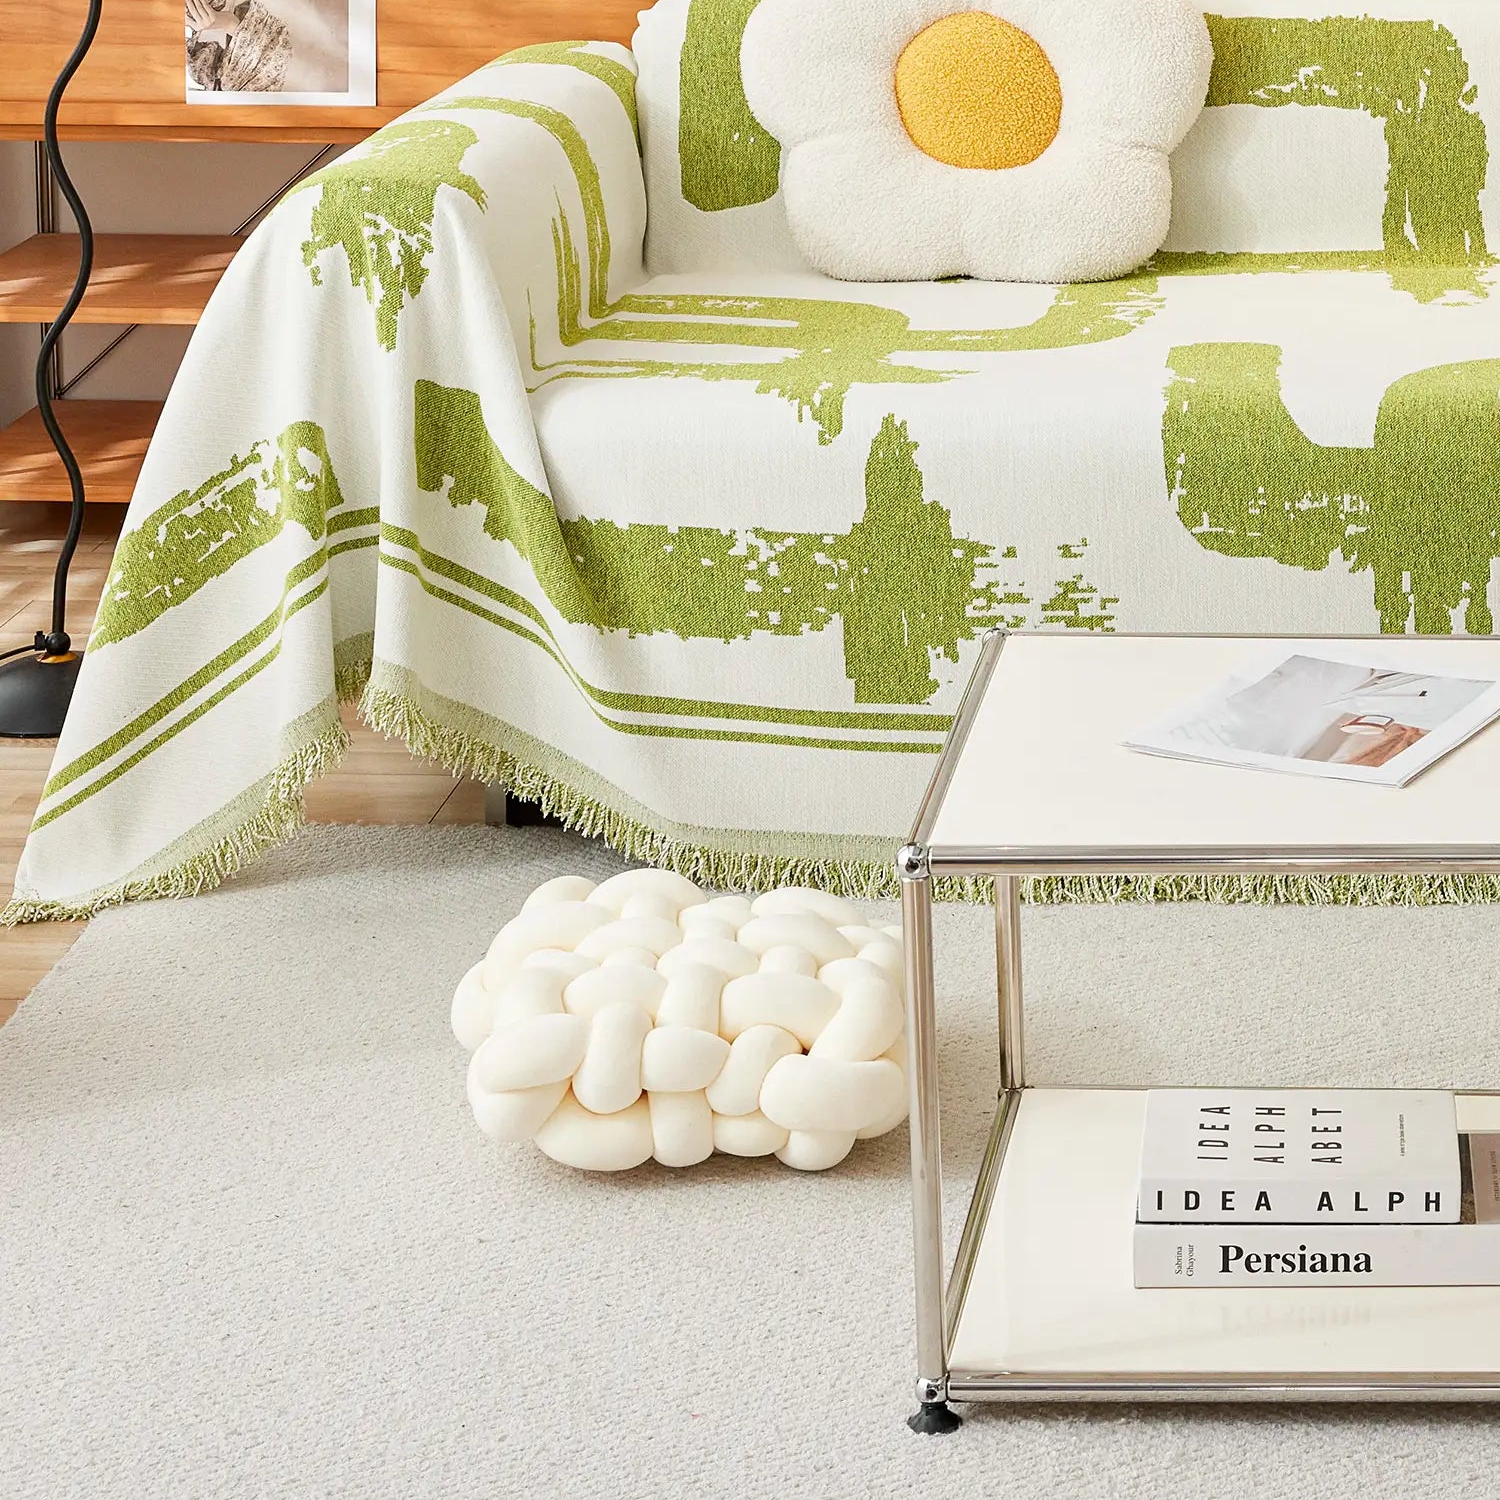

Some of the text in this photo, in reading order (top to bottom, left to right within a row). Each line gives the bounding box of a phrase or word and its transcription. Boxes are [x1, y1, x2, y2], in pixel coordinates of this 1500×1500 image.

[1197, 1106, 1230, 1160] IDEA
[1253, 1107, 1285, 1164] ALPH
[1311, 1108, 1342, 1164] ABET
[1156, 1190, 1441, 1212] IDEA ALPH
[1175, 1246, 1183, 1275] Sabrina
[1186, 1244, 1196, 1277] Ghayour
[1219, 1244, 1373, 1274] Persiana
